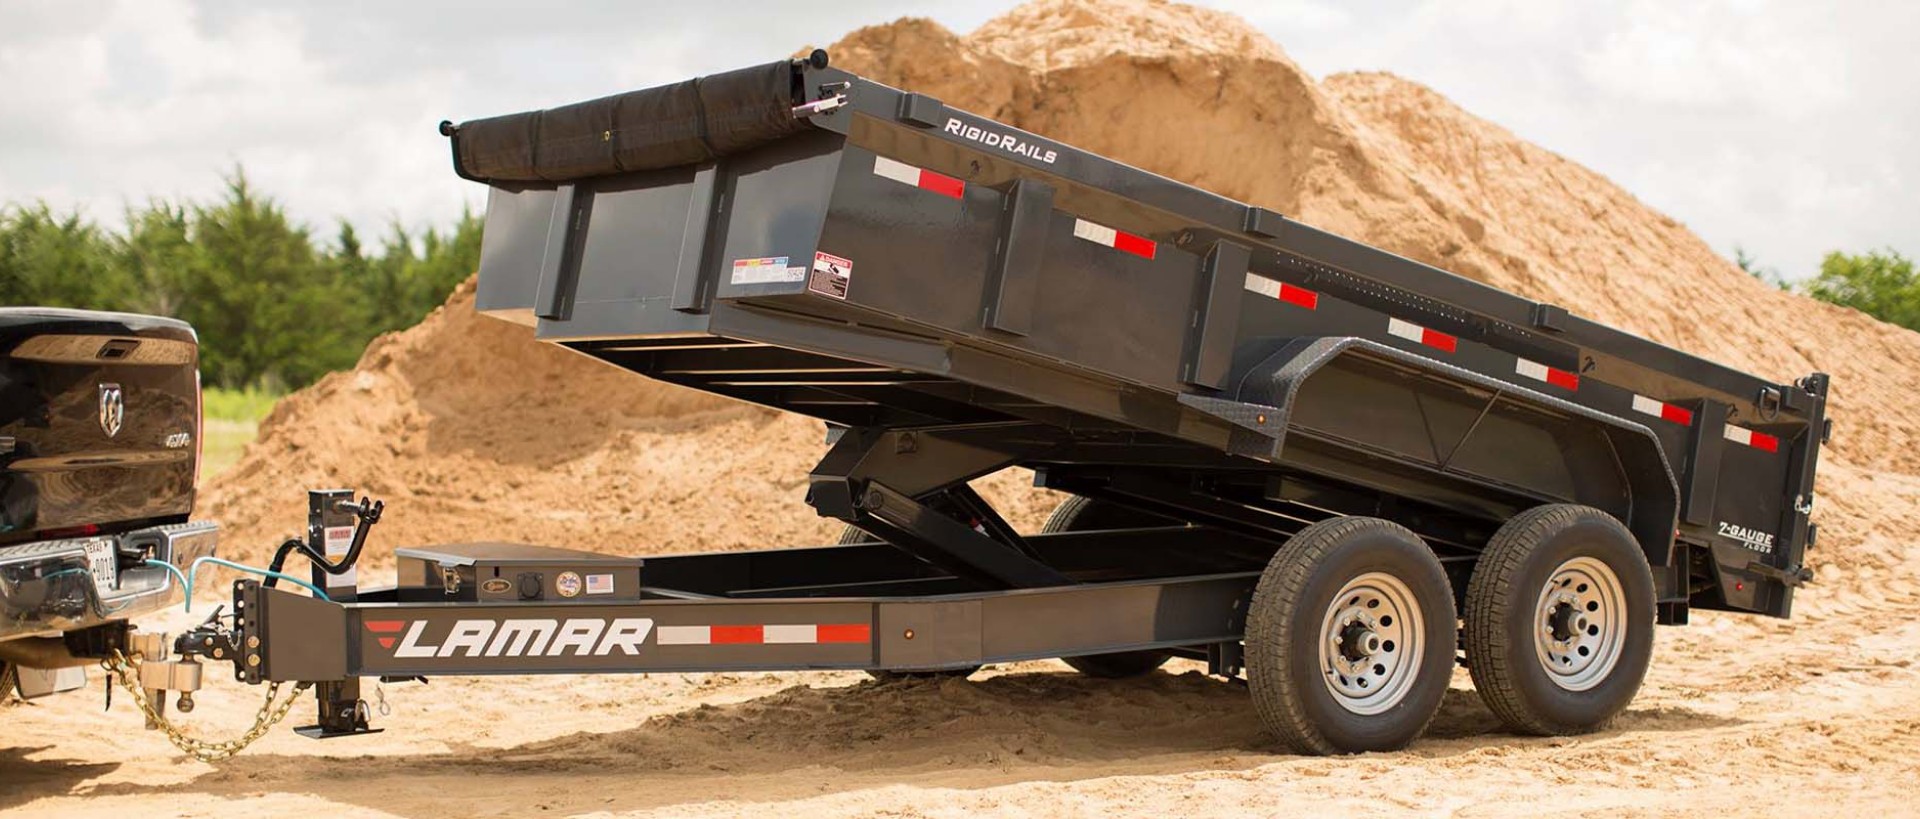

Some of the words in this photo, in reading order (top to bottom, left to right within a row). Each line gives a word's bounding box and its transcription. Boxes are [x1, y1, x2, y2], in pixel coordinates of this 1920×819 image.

[1719, 521, 1774, 545] 7-GAUGE
[1743, 542, 1772, 554] FLOOR
[394, 618, 653, 658] LAMAR
